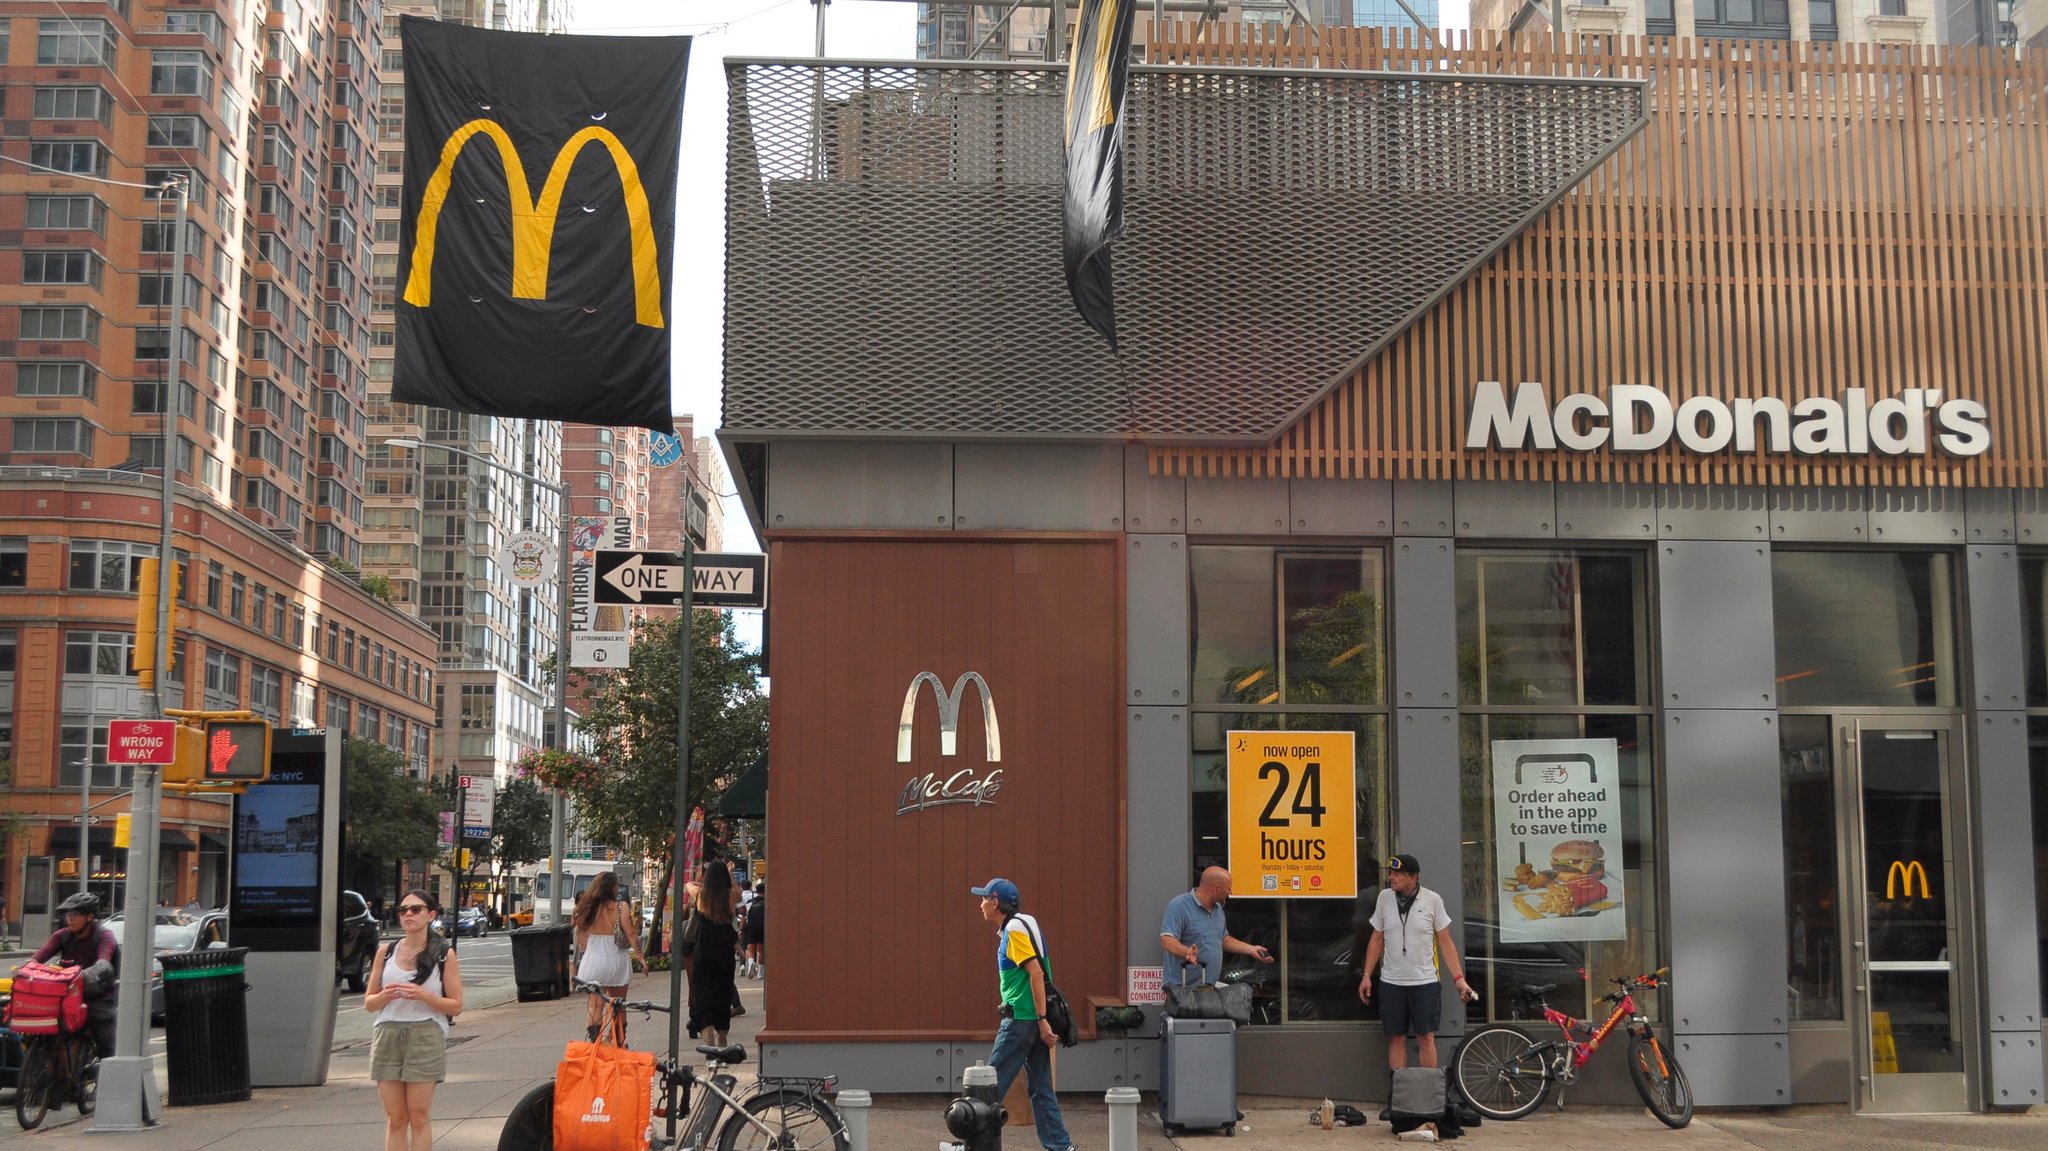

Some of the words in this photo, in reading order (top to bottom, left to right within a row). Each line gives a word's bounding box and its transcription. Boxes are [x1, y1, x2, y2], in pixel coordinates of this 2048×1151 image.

[1465, 381, 1990, 456] McDonald's
[614, 517, 632, 548] MAD
[621, 567, 668, 588] ONE
[692, 569, 743, 590] WAY
[570, 563, 589, 632] FLATIRON
[292, 728, 326, 736] LinkNYC
[121, 736, 164, 747] WRONG
[128, 748, 154, 759] WAY
[1263, 745, 1288, 757] now
[1291, 745, 1320, 760] open
[282, 771, 304, 780] NYC
[462, 778, 469, 787] 3
[897, 769, 1003, 813] McCafé
[1258, 761, 1326, 827] 24
[1508, 789, 1555, 804] Order
[1557, 788, 1606, 803] ahead
[1519, 805, 1534, 819] in
[1537, 805, 1564, 819] the
[1567, 807, 1598, 823] app
[1510, 823, 1527, 836] to
[1531, 823, 1568, 835] save
[1570, 821, 1607, 835] time
[1261, 831, 1326, 861] hours
[1261, 864, 1282, 872] thursday
[1286, 864, 1300, 872] friday
[1304, 864, 1325, 872] saturday
[1133, 970, 1162, 980] SPRINKLE
[1133, 981, 1148, 990] FIRE
[1149, 981, 1162, 990] DEP
[1130, 992, 1167, 1001] CONNECTIO
